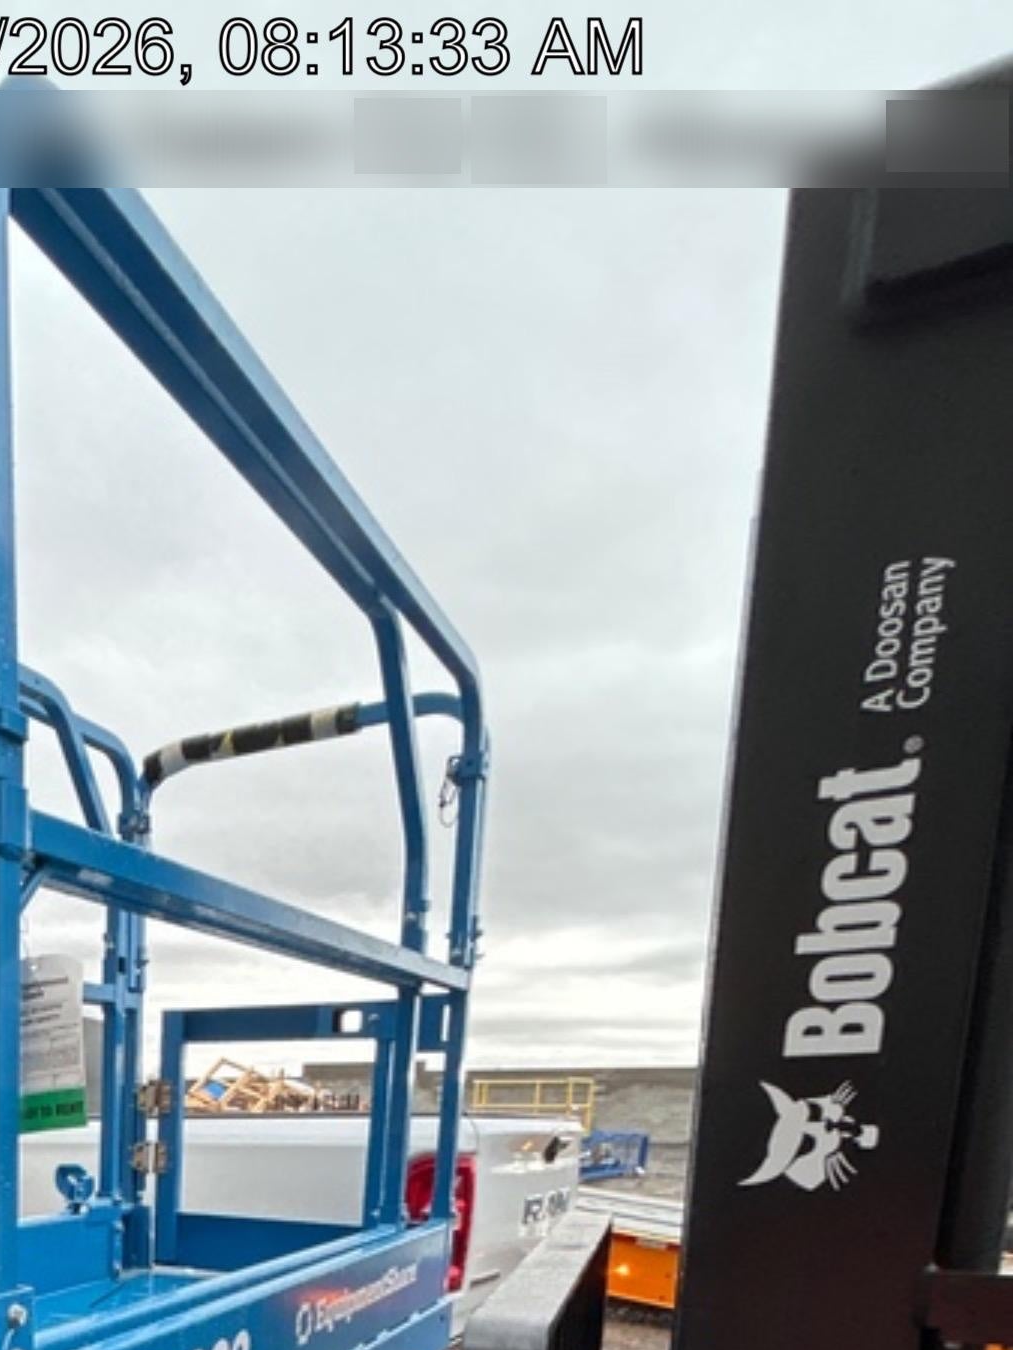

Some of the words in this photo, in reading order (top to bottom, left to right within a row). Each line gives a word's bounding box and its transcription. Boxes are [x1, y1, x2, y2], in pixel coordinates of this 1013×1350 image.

[864, 560, 911, 682] Doosan
[896, 557, 956, 709] Company
[860, 689, 895, 712] A
[782, 757, 922, 1057] Bobcat
